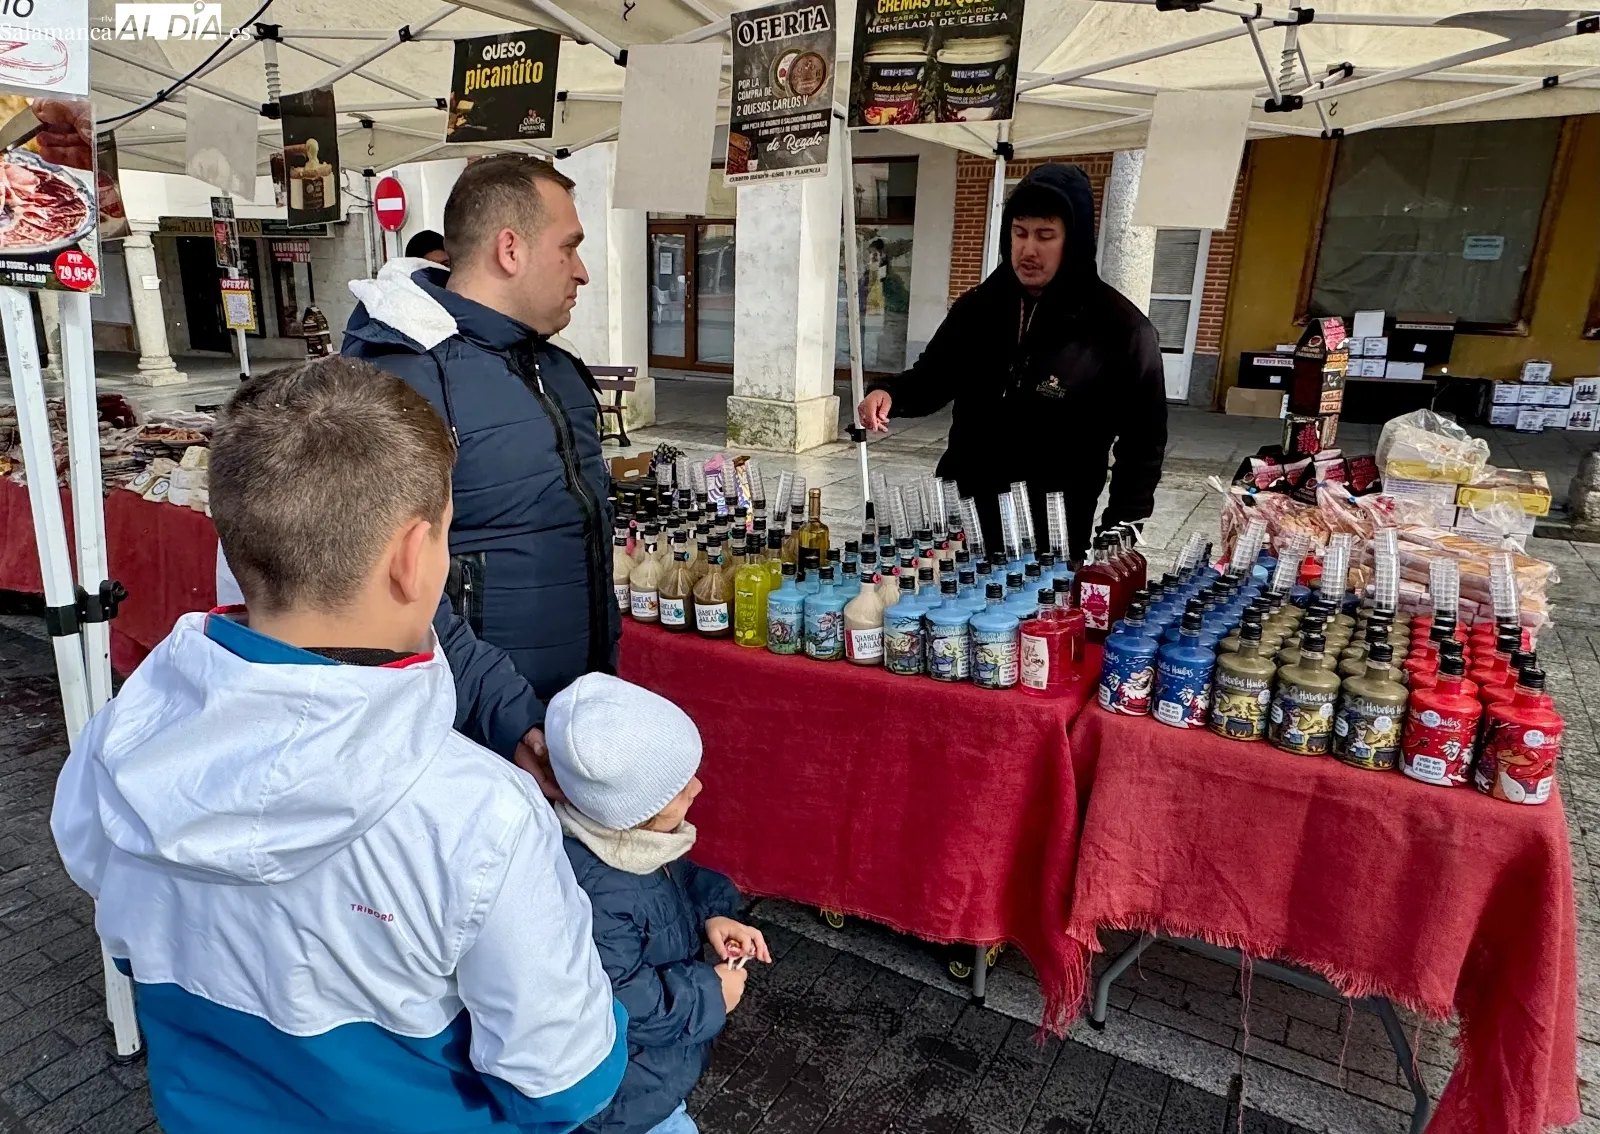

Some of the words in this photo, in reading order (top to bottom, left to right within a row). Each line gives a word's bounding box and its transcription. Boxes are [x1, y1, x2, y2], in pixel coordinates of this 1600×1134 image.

[867, 19, 935, 35] MERMELADA
[939, 17, 955, 27] DE
[960, 12, 1008, 25] CEREZA
[893, 13, 919, 23] CABRA
[930, 10, 942, 18] DE
[944, 7, 973, 17] OVEJA
[975, 6, 995, 14] CON
[737, 5, 831, 47] OFERTA
[482, 41, 526, 61] QUESO
[464, 58, 544, 95] picantito
[738, 79, 751, 90] POR
[751, 77, 760, 89] LA
[737, 88, 762, 102] COMPRA
[764, 86, 773, 97] DE
[736, 105, 742, 117] 2
[743, 102, 771, 116] QUESOS
[772, 96, 801, 111] CARLOS
[802, 94, 809, 106] V
[767, 138, 780, 152] de
[783, 131, 823, 155] Regalo
[58, 265, 95, 283] 79,95€
[221, 279, 249, 291] OFERTA
[350, 903, 394, 922] TRIBORD
